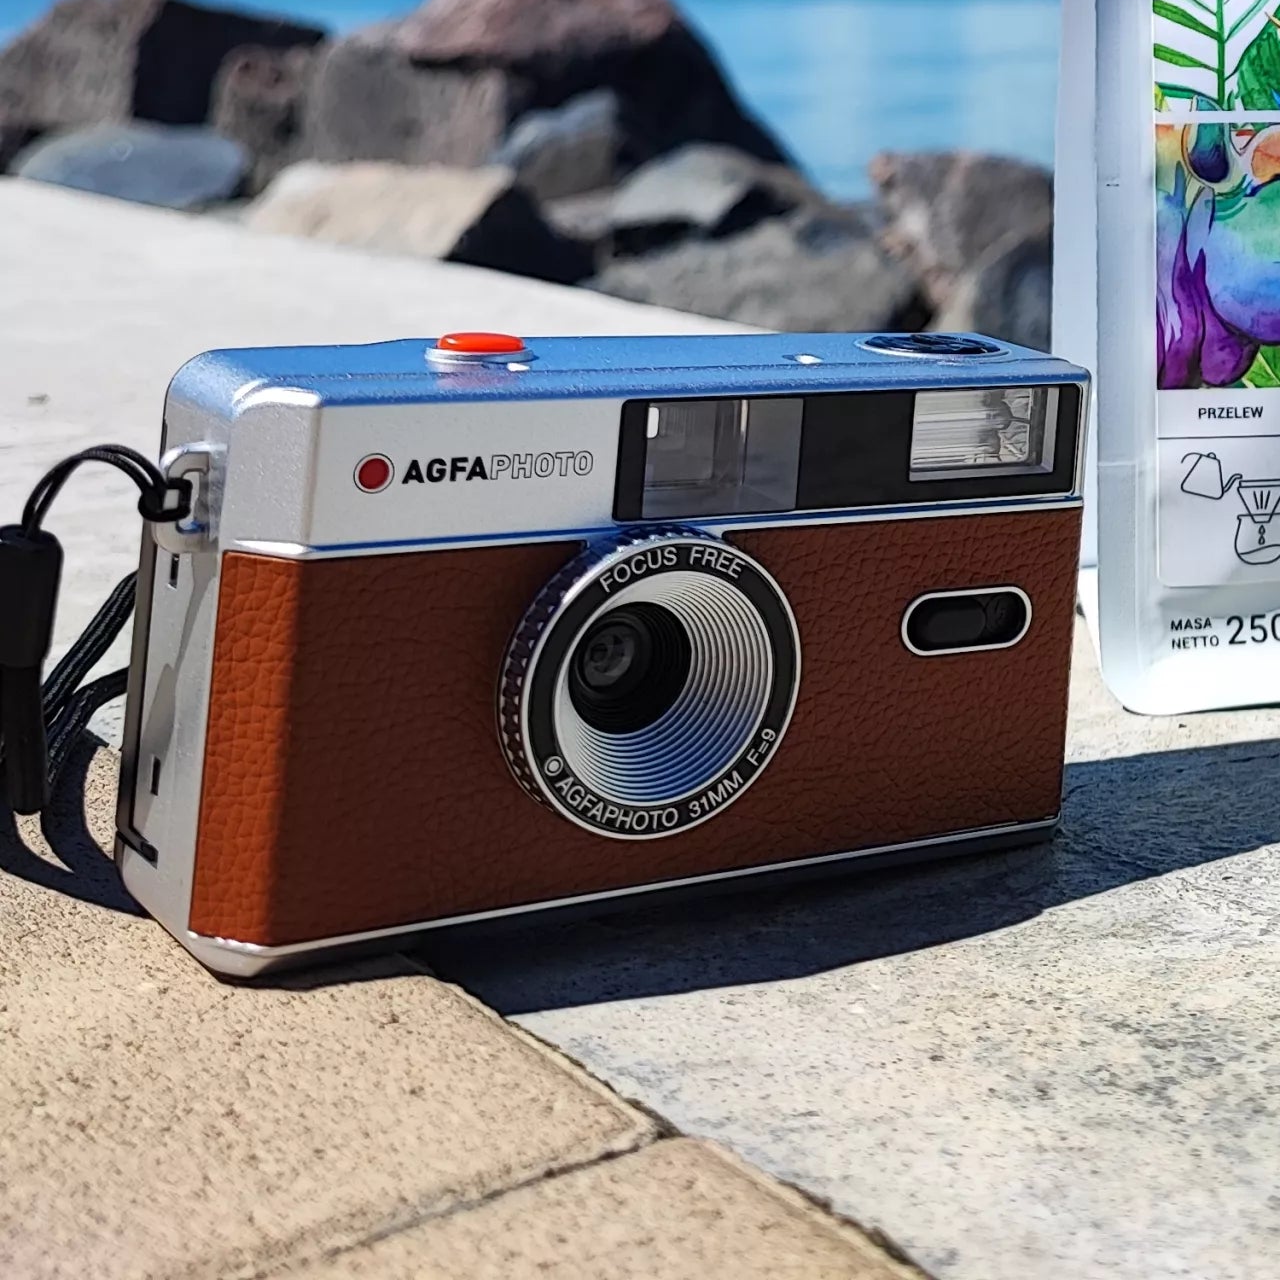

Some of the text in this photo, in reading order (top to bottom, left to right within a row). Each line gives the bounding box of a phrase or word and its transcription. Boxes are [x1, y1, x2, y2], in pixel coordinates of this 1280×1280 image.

[1197, 405, 1265, 420] PRZELEW
[401, 450, 595, 485] AGFAPHOTO
[599, 545, 747, 594] FOCUS FREE
[1170, 617, 1213, 632] MASA
[1171, 634, 1220, 650] NETTO
[554, 727, 778, 832] AGFAPHOTO 31MM F=9
